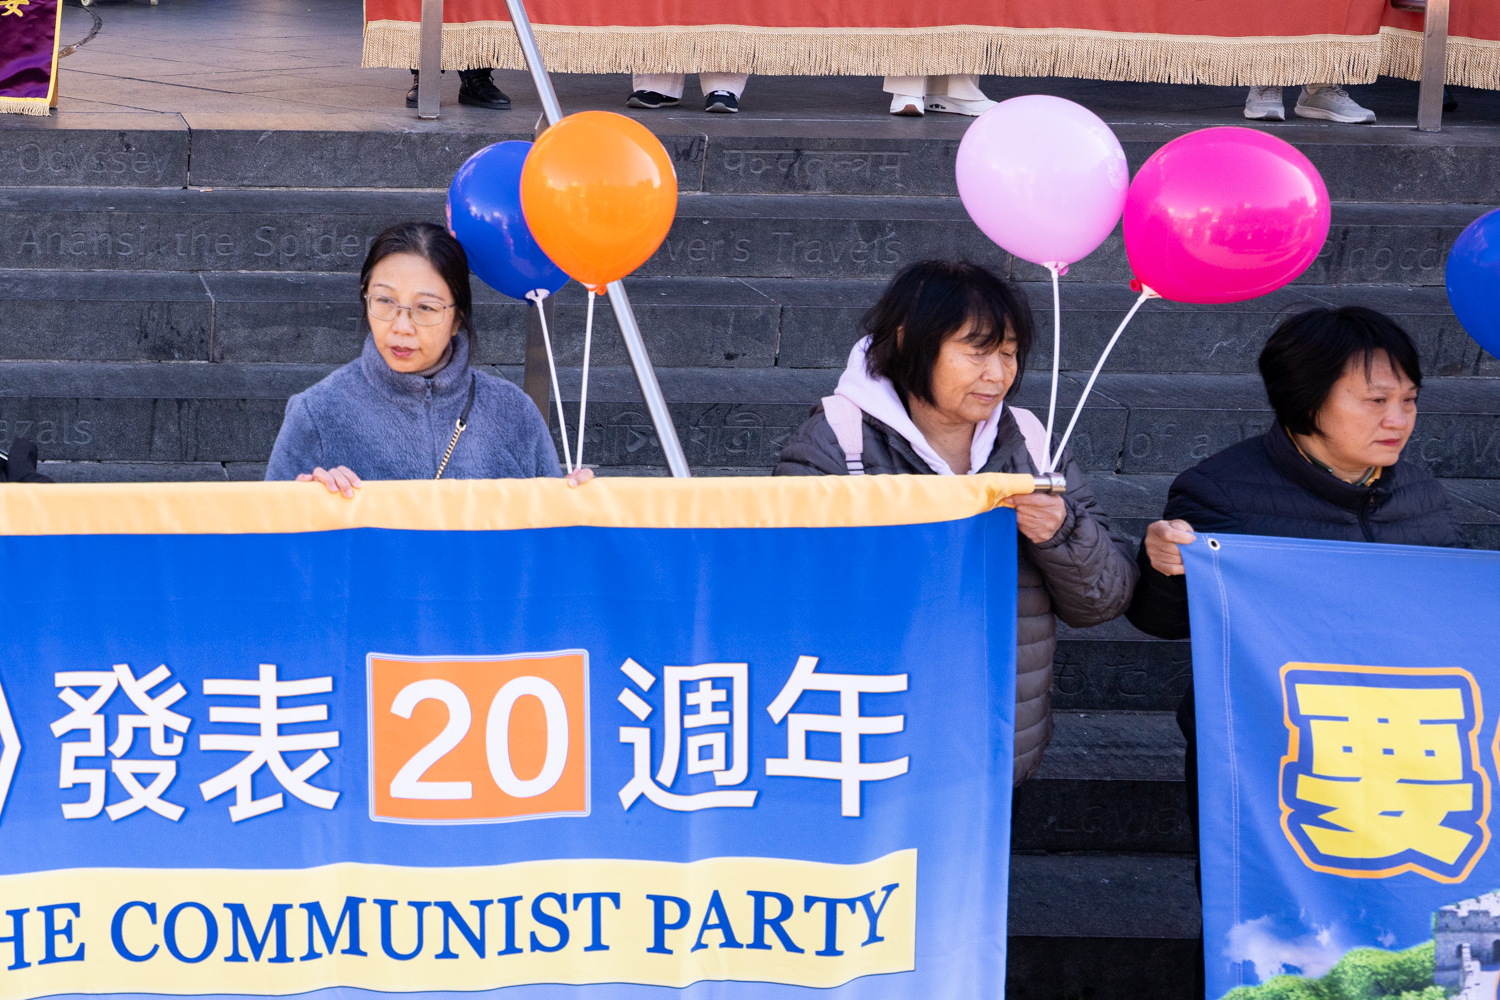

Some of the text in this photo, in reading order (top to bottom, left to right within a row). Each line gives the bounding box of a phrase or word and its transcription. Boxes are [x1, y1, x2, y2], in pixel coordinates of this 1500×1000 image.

[387, 674, 571, 803] 20
[617, 655, 911, 818] 週年
[1294, 682, 1475, 867] 要
[108, 889, 623, 965] COMMUNIST
[644, 880, 901, 958] PARTY
